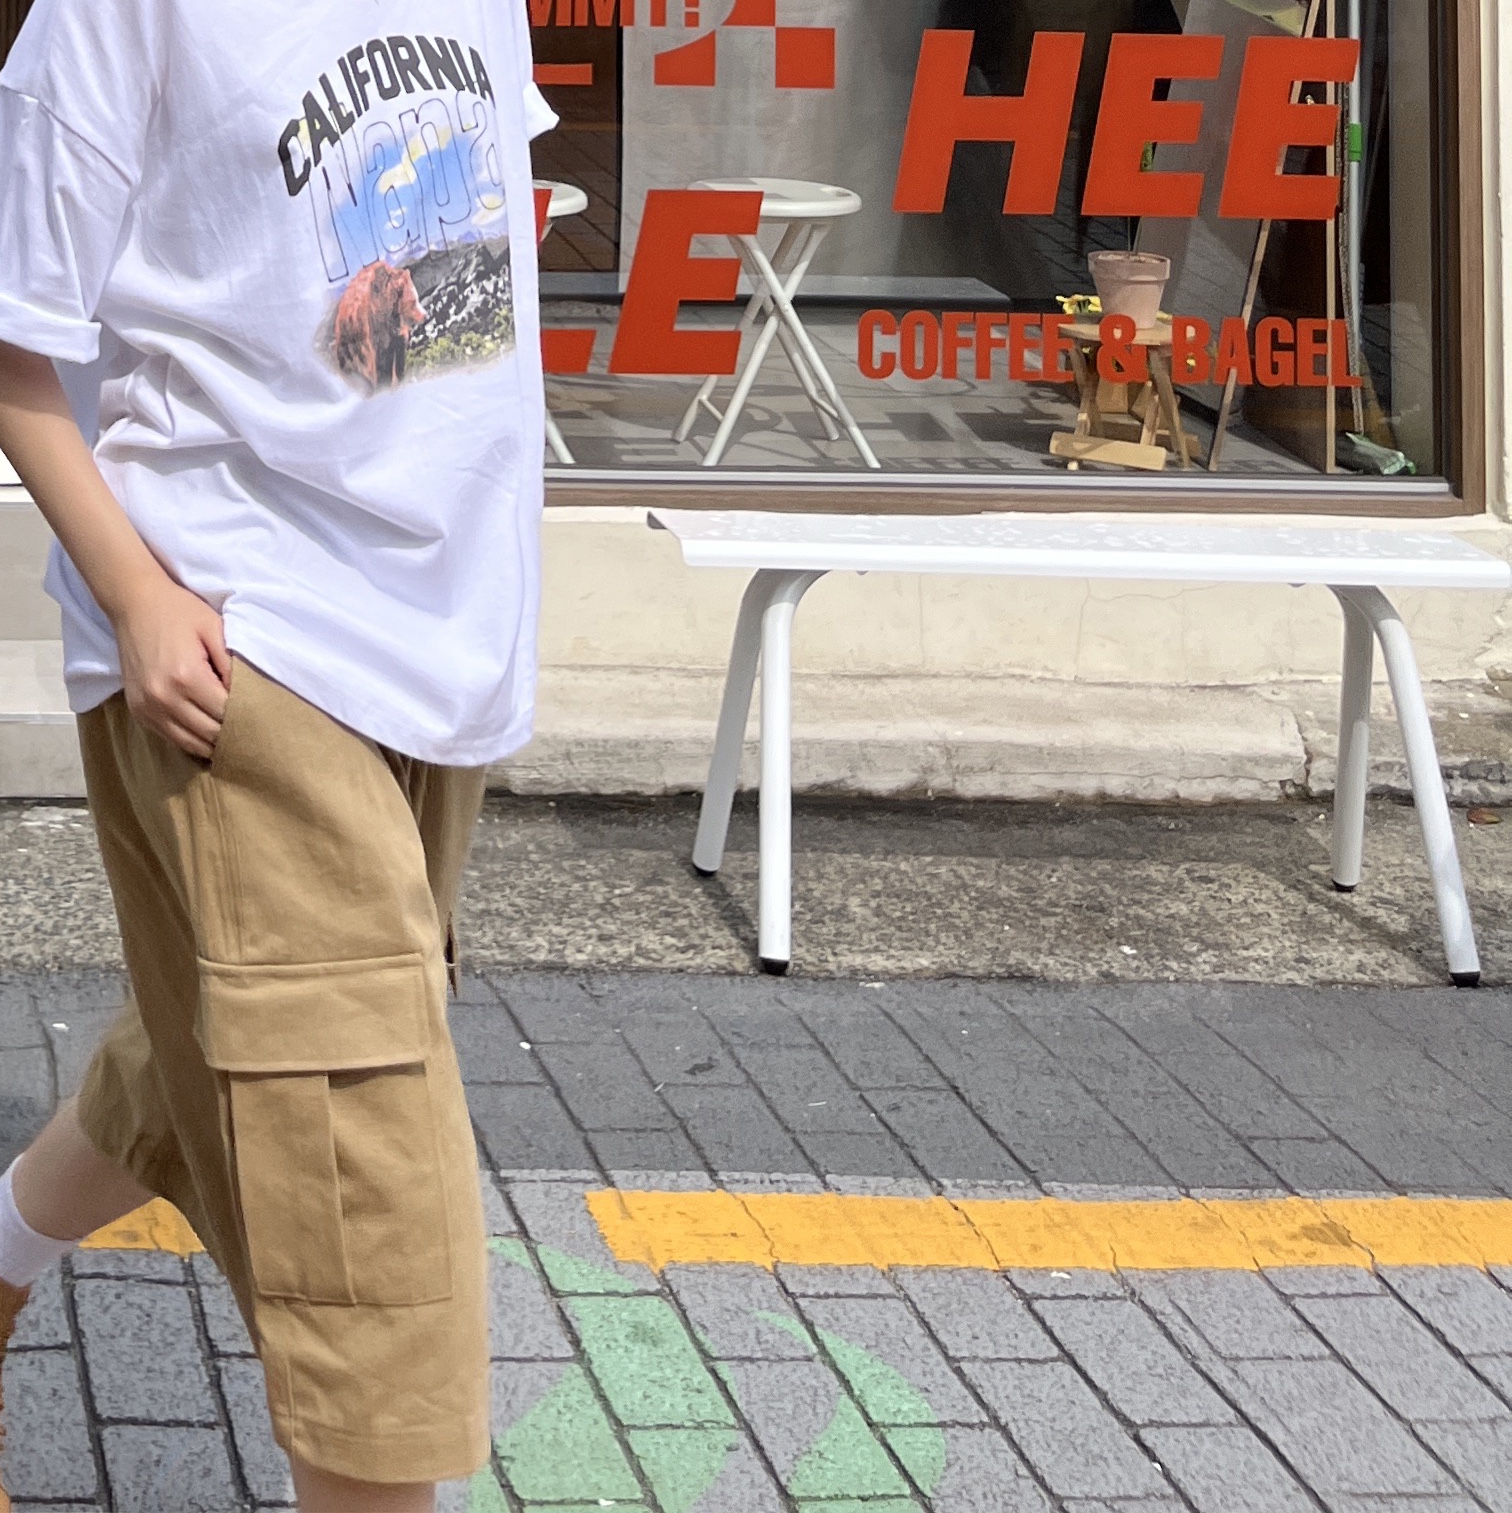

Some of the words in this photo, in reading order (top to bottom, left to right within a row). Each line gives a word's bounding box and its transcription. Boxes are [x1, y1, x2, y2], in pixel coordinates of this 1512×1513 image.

[277, 35, 497, 197] CALIFORNIA
[306, 89, 507, 284] Napa
[892, 28, 1362, 221] HEE
[856, 309, 1074, 383] COFFEE
[1096, 313, 1148, 386] &
[1170, 314, 1364, 390] BAGEL
